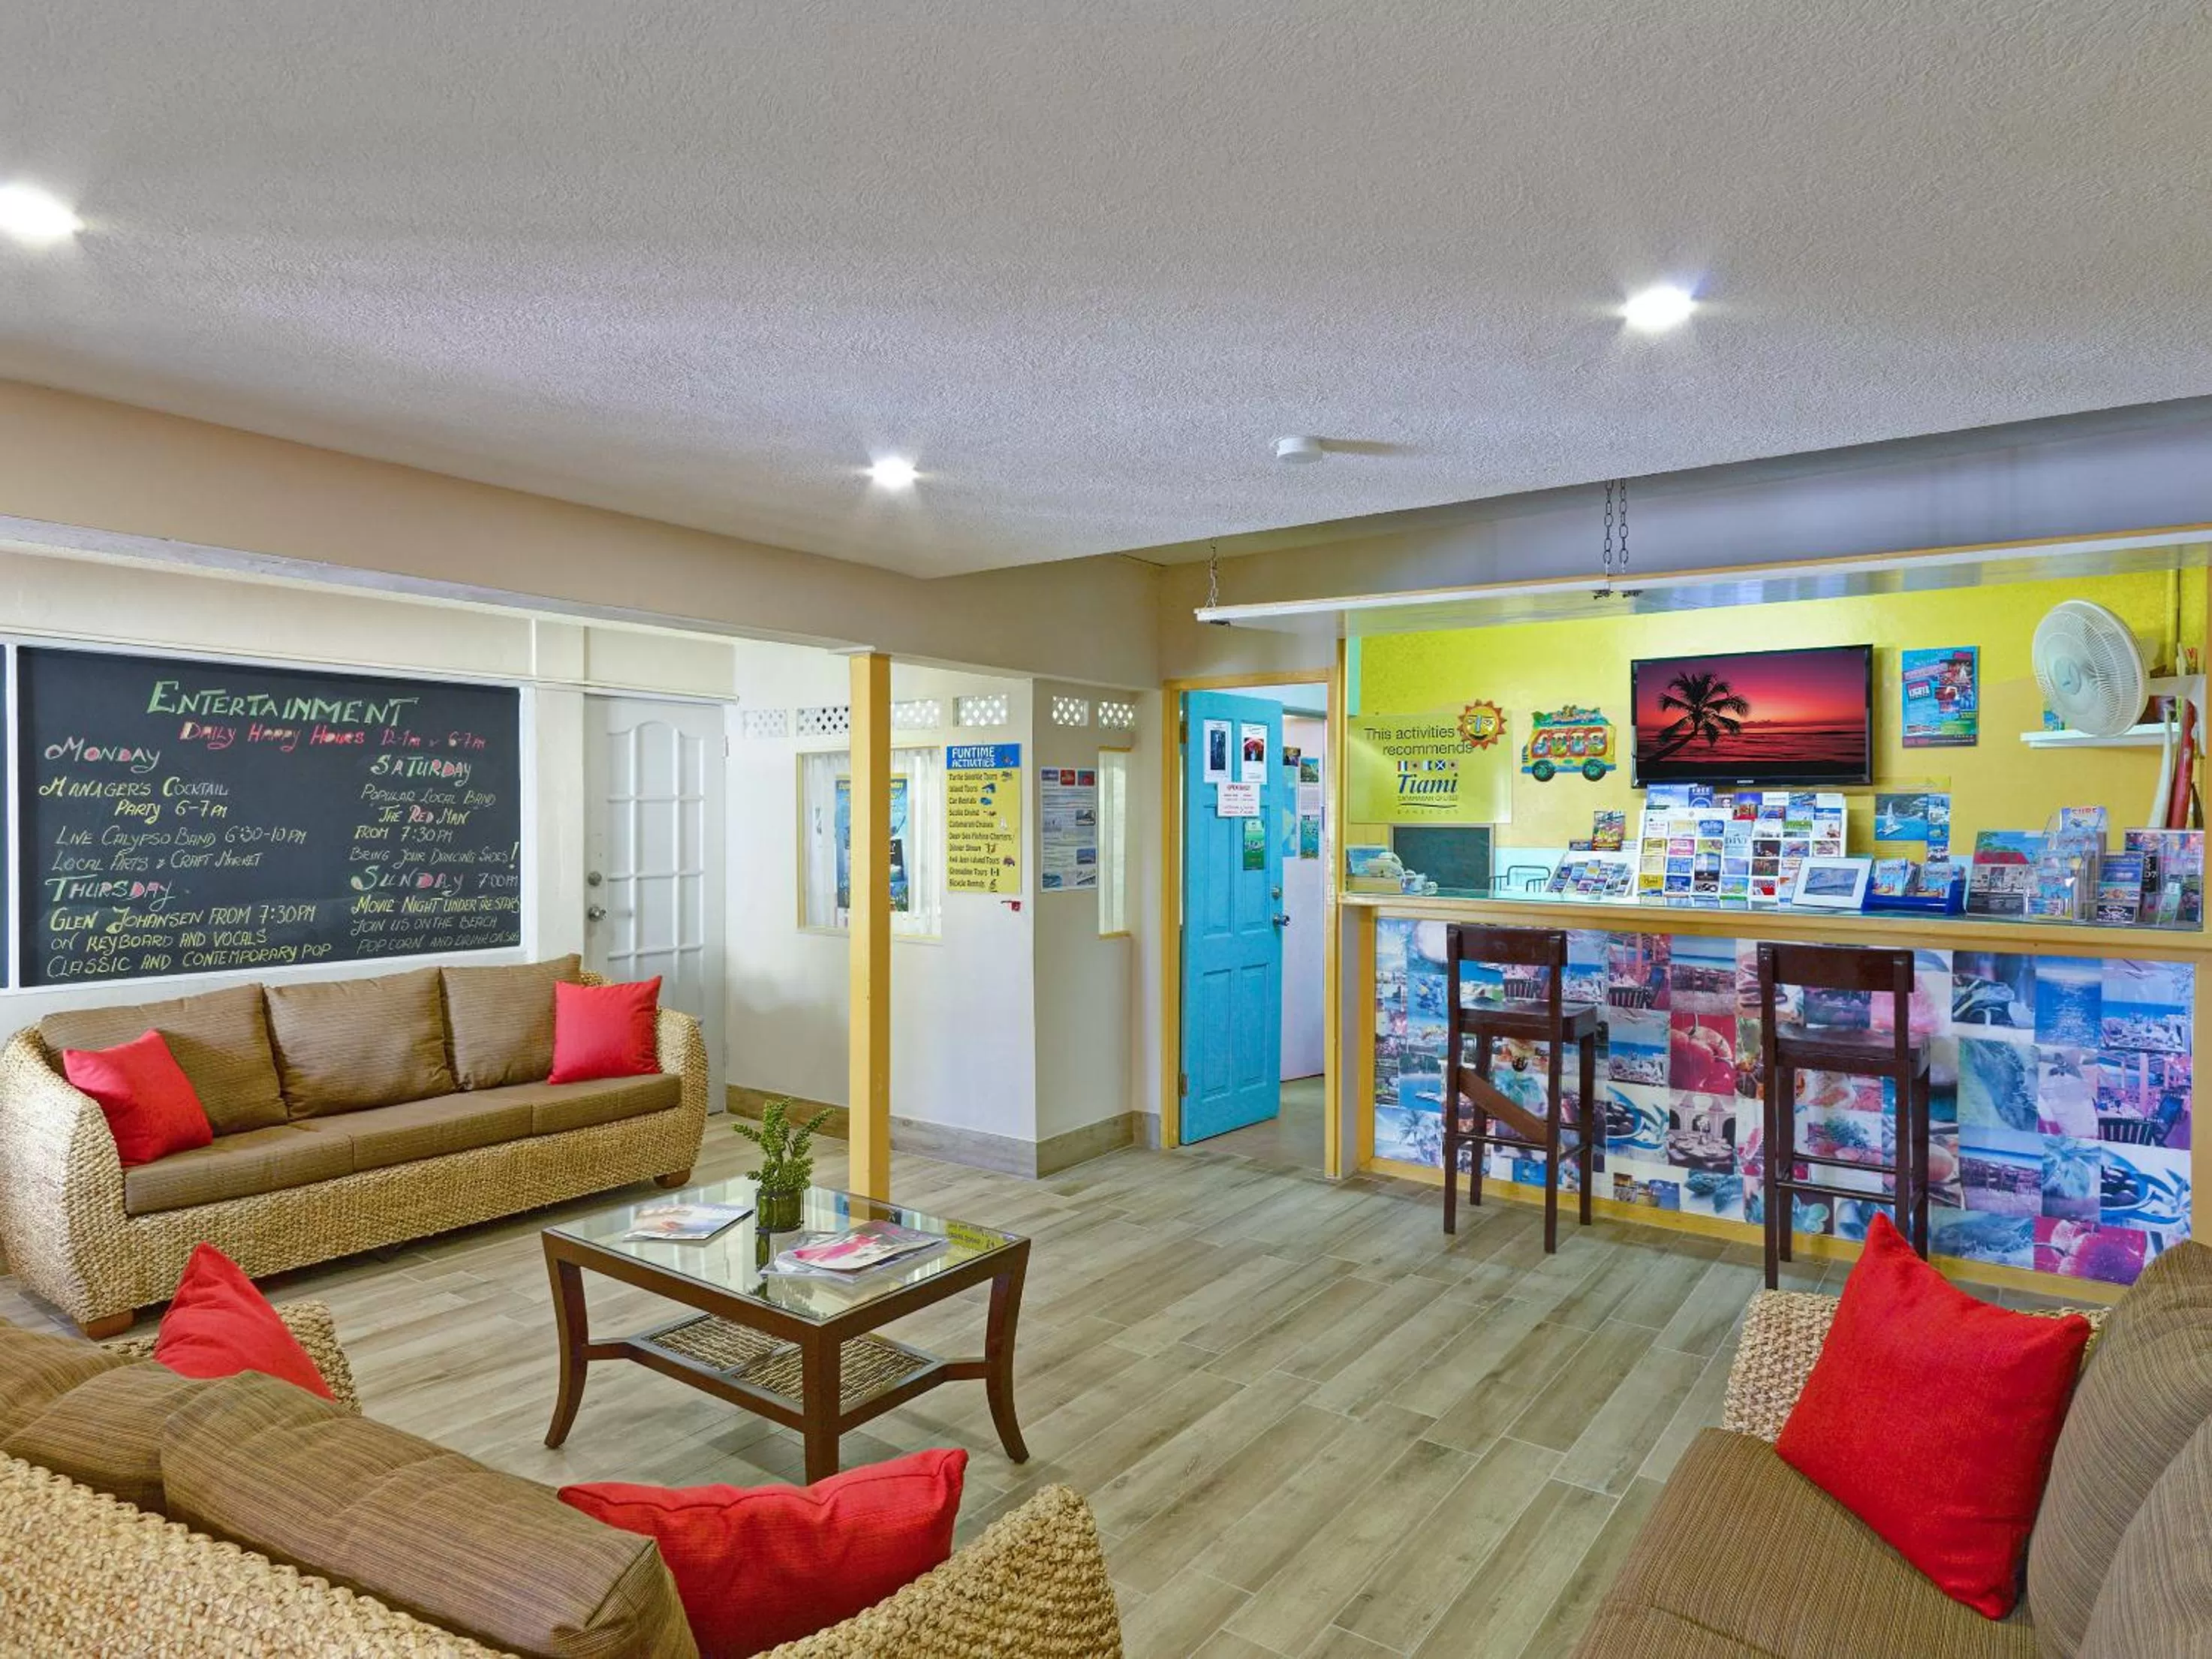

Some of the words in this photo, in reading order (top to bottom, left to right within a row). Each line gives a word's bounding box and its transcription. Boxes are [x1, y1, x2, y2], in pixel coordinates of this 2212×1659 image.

[147, 681, 420, 727] ENTERTAINMENT
[179, 721, 236, 750] DAILY
[247, 721, 301, 752] HAPPY
[1364, 727, 1391, 741] This
[1395, 725, 1455, 739] activities
[44, 736, 160, 773] MONDAY
[952, 746, 995, 759] FUNTIME
[1383, 742, 1473, 756] recommends
[370, 754, 471, 787] SATURDAY
[952, 757, 996, 768] ACTIVITIES
[39, 775, 151, 798] MANAGER'S
[163, 776, 228, 796] COCKTAIL
[1398, 772, 1458, 793] Tiami
[360, 784, 415, 802] POPULAR
[420, 788, 457, 805] LOCAL
[464, 790, 496, 806] BAND
[115, 799, 161, 825] PARTY
[378, 805, 403, 822] THE
[408, 805, 434, 823] RED
[436, 807, 471, 825] MAN
[55, 826, 93, 845] LIVE
[101, 826, 171, 854] CALYPSO
[174, 826, 216, 849] BAND
[354, 825, 389, 840] FROM
[51, 851, 104, 871] LOCAL
[110, 851, 149, 871] ARTS
[170, 849, 213, 869] CRAFT
[215, 849, 263, 867] MARKET
[350, 847, 390, 862] BRING
[393, 848, 426, 869] YOUR
[429, 848, 476, 866] DANCING
[351, 865, 464, 896] SUNDAY
[45, 874, 176, 911] THURSDAY
[351, 895, 394, 914] MOVIE
[402, 896, 443, 914] NIGHT
[444, 899, 477, 913] UNDER
[50, 907, 99, 932] GLEN
[106, 906, 203, 934] JOHANSEN
[208, 905, 251, 925] FROM
[351, 918, 386, 936] JOIN
[390, 919, 409, 932] US
[414, 917, 430, 930] ON
[432, 917, 453, 929] THE
[459, 916, 497, 930] BEACH
[51, 932, 80, 950] ON
[86, 935, 173, 956] KEYBOARD
[179, 932, 206, 947] AND
[213, 928, 267, 947] VOCALS
[47, 956, 132, 978] CLASSIC
[141, 954, 172, 971] AND
[182, 945, 297, 967] CONTEMPORARY
[302, 944, 332, 959] POP
